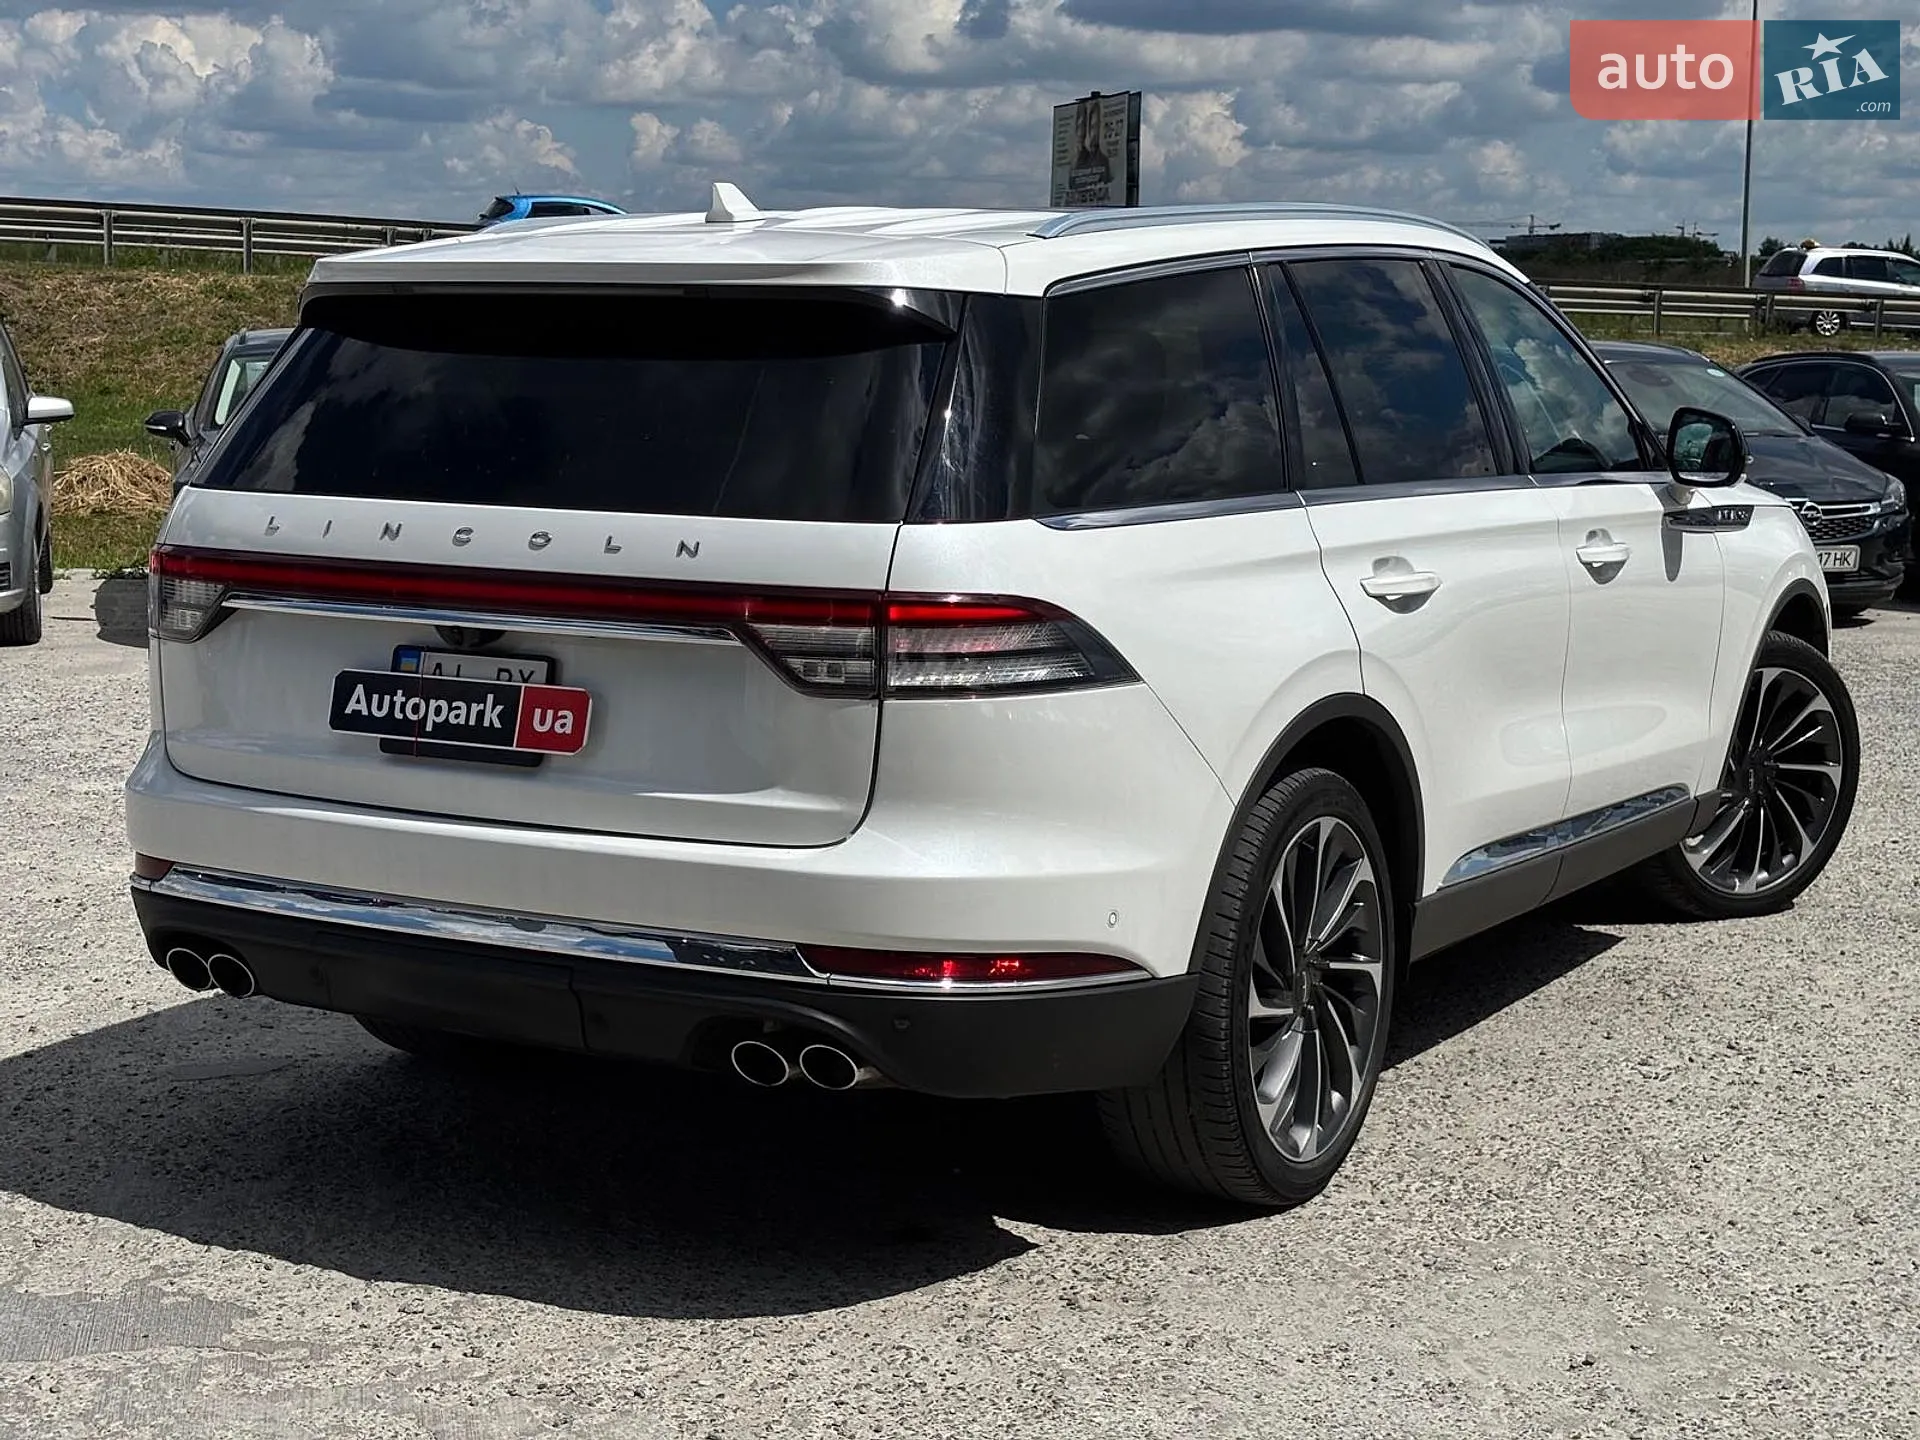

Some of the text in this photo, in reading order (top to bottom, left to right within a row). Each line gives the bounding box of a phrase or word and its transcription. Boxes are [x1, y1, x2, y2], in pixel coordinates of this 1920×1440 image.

[265, 516, 701, 559] LINCOLN
[1833, 551, 1853, 567] HK
[344, 683, 575, 736] Autopark ua
